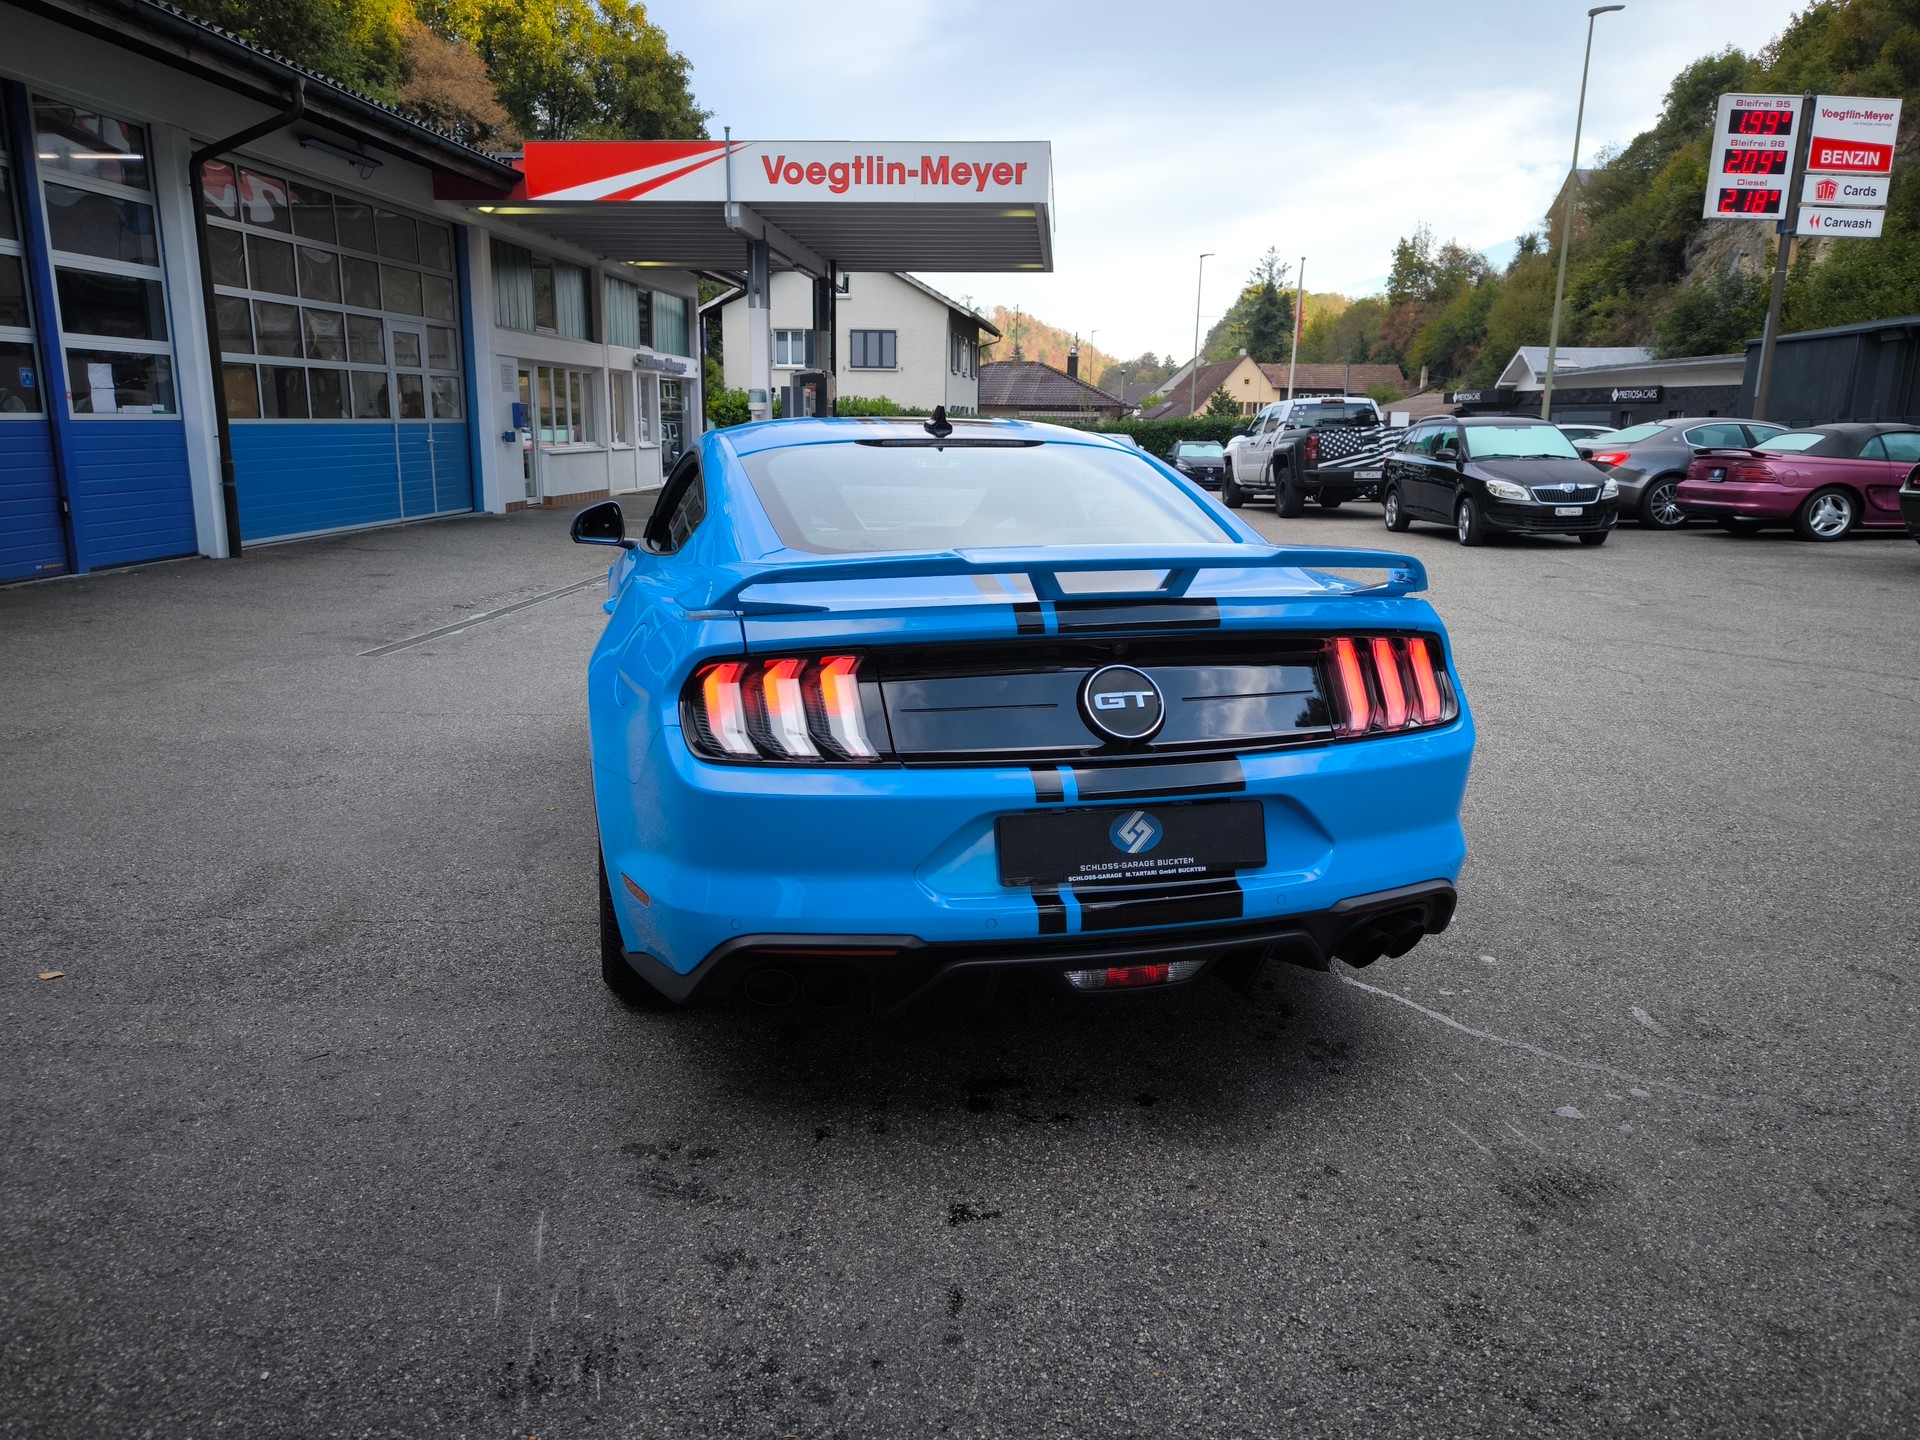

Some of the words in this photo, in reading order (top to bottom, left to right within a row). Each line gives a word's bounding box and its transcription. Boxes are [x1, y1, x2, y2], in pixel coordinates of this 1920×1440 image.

[1736, 99, 1772, 107] Bleifrei
[1821, 108, 1894, 122] Voegtlin-Meyer
[1731, 139, 1767, 147] Bleifrei
[1770, 140, 1785, 148] 98
[1820, 149, 1880, 166] BENZIN
[761, 155, 1028, 194] Voegtlin-Meyer
[1737, 179, 1768, 187] Diesel
[1843, 185, 1877, 197] Cards
[1824, 216, 1872, 229] Carwash
[1618, 390, 1643, 399] PRETIOSA
[1643, 389, 1658, 399] CARS
[1094, 691, 1154, 710] GT
[1080, 859, 1155, 871] SCHLOSS-GARAGE
[1157, 857, 1195, 866] BUCKTEN
[1068, 872, 1123, 881] SCHLOSS-GARAGE
[1125, 870, 1158, 878] M.TARTARI
